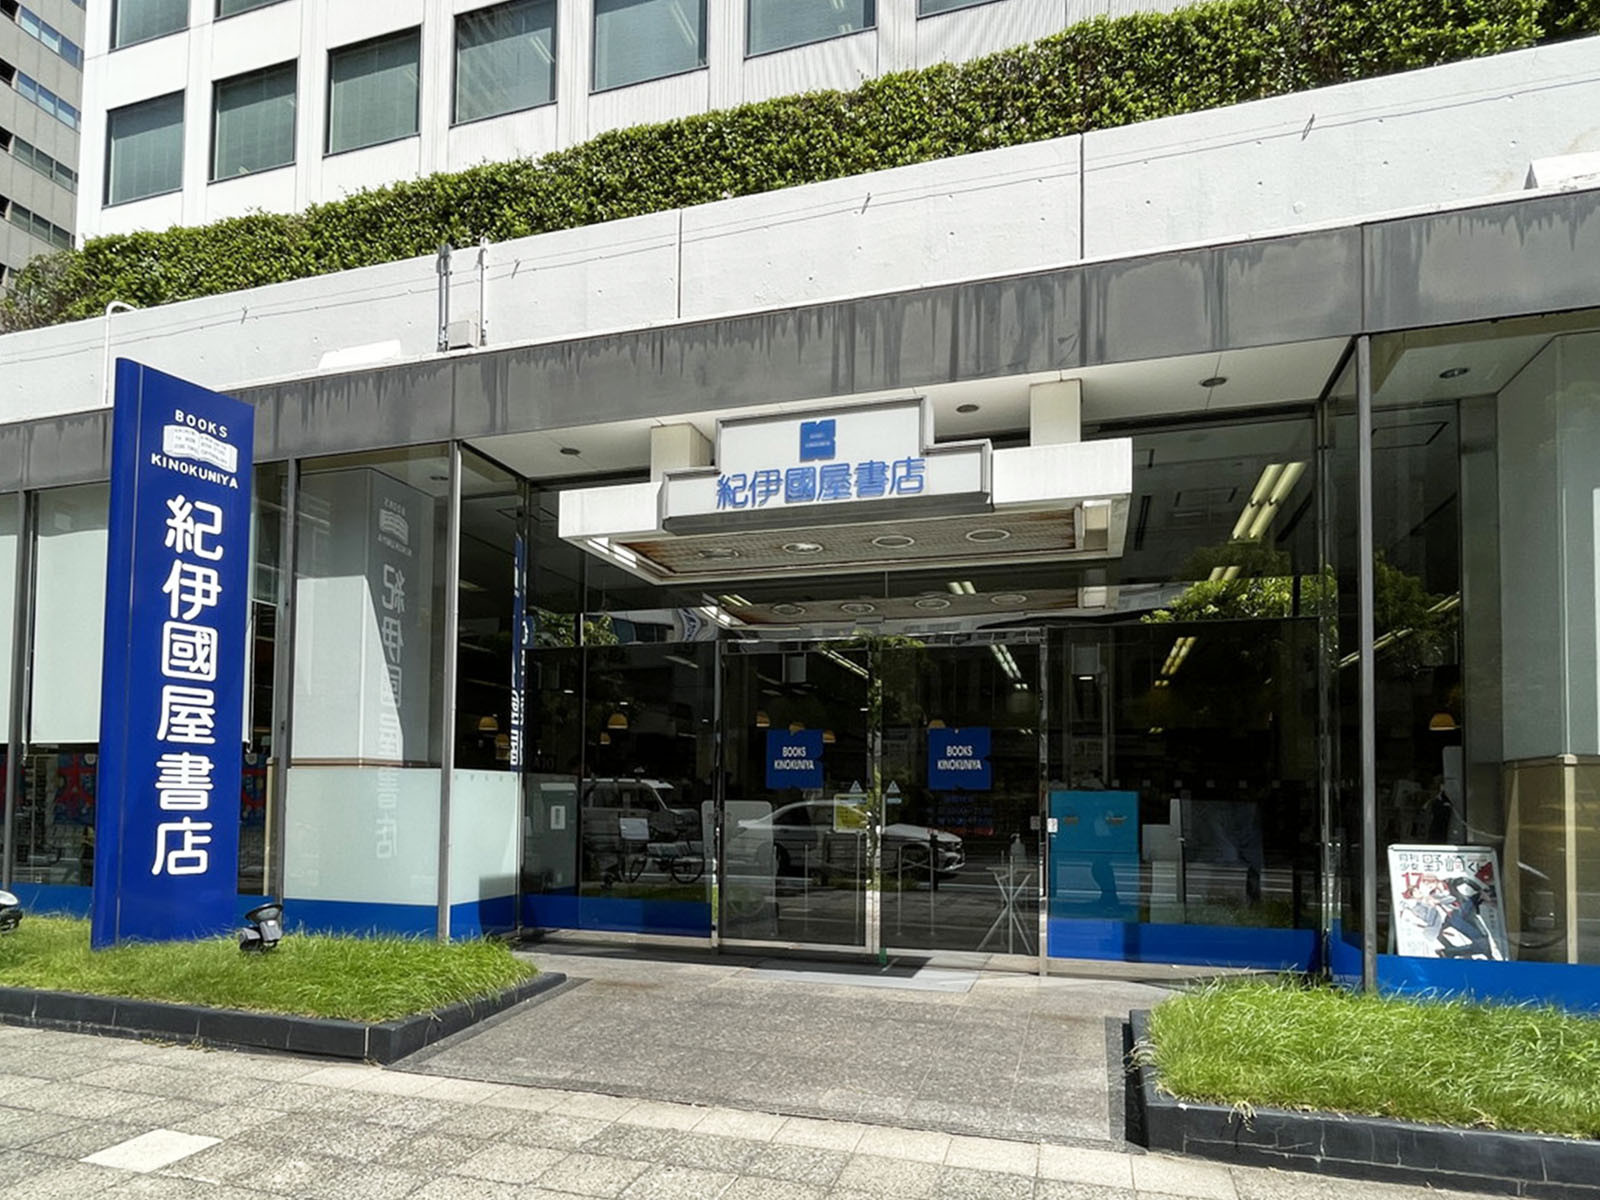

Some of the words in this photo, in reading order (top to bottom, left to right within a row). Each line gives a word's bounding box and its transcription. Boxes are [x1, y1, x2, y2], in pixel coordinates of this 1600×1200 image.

[175, 409, 228, 438] BOOKS
[151, 453, 239, 489] KINOKUNIYA
[716, 456, 926, 510] 紀伊國屋書店
[151, 494, 224, 875] 紀伊國屋書店
[782, 746, 806, 757] BOOKS
[946, 745, 972, 757] BOOKS
[1401, 872, 1424, 889] 17
